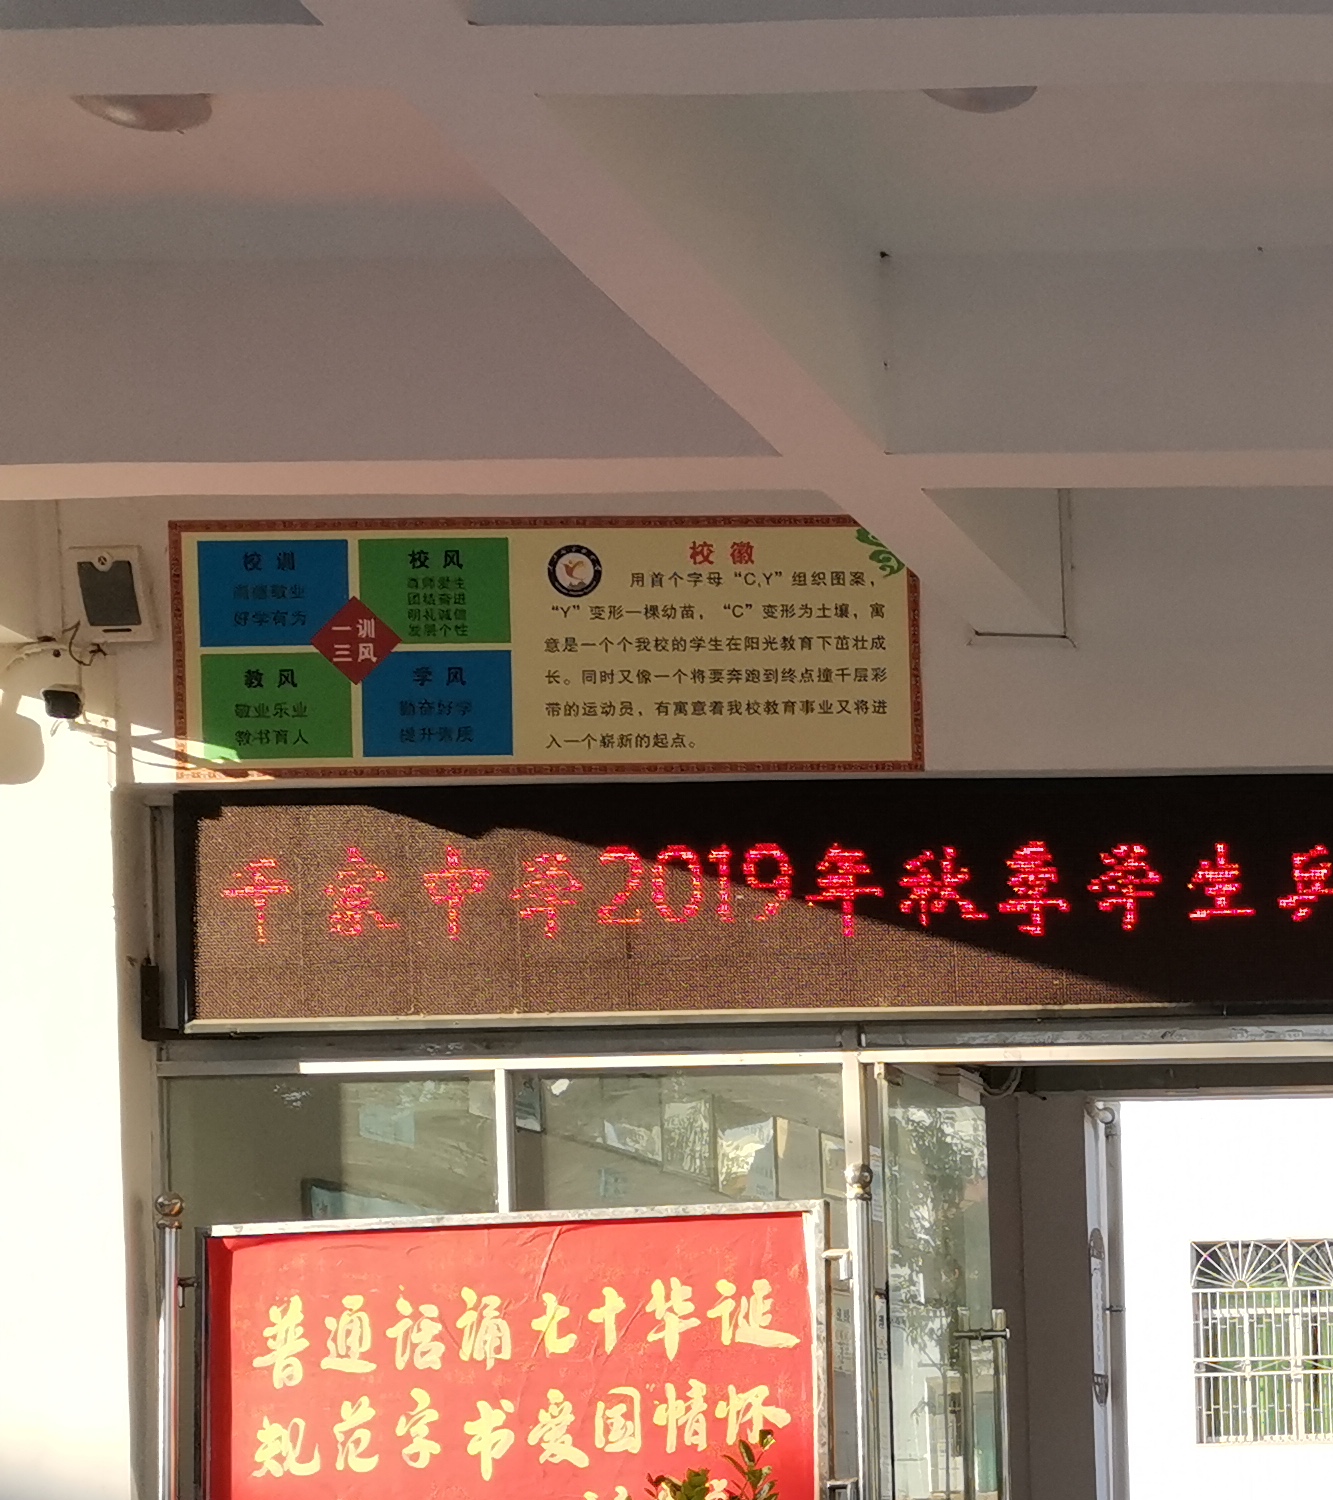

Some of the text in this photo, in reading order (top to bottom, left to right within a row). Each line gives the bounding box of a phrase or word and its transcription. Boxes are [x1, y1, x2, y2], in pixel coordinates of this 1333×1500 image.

[243, 551, 296, 572] 校训
[407, 549, 464, 570] 校风
[690, 540, 755, 566] 校徽
[233, 610, 307, 627] 好学有为
[331, 618, 376, 640] 一训
[332, 643, 378, 663] 三风
[244, 668, 298, 689] 教风
[413, 666, 466, 687] 学风
[235, 729, 309, 746] 教书育人
[253, 1276, 800, 1391] 普通话诵七十华诞
[252, 1378, 791, 1482] 规范字书爱国情怀
